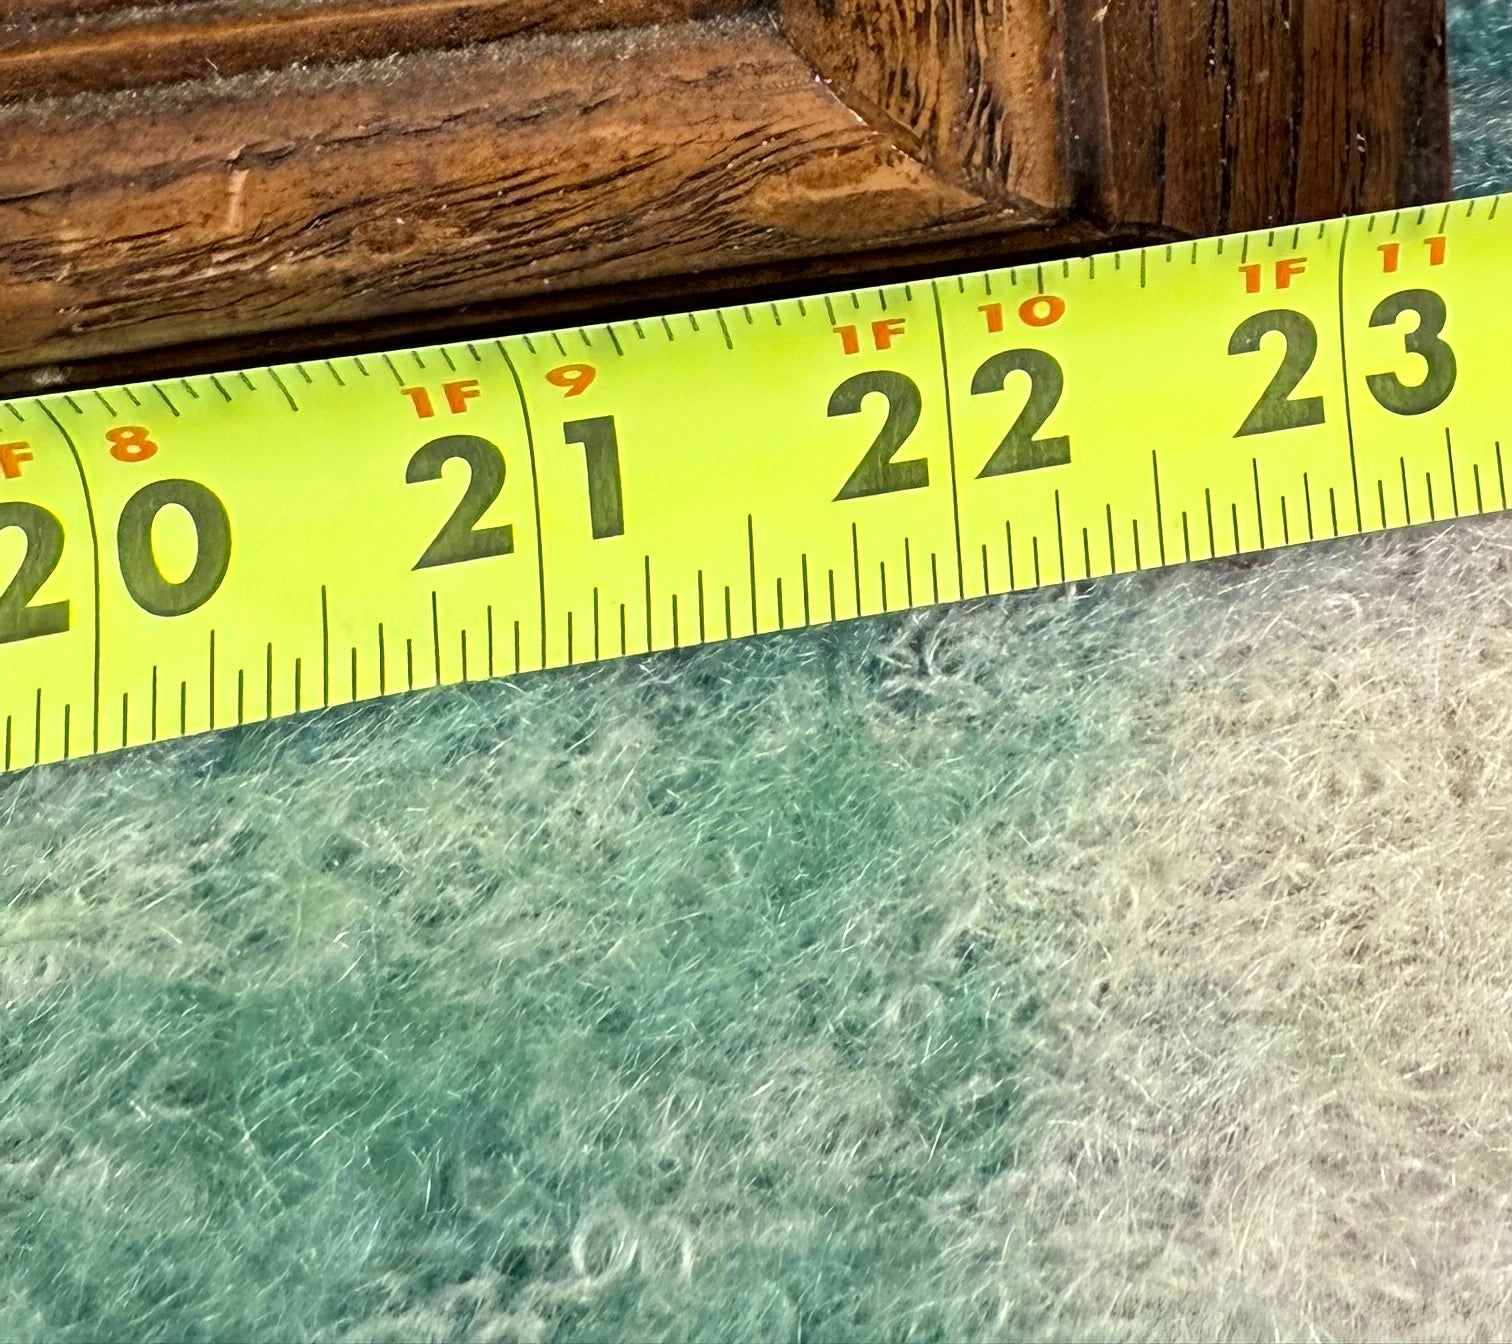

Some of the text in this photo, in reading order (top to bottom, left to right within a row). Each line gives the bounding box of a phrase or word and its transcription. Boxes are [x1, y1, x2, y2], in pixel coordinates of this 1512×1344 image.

[1238, 236, 1447, 294] 1F 11
[833, 295, 1066, 355] 1F 10
[1227, 288, 1458, 439] 23
[400, 363, 598, 419] 1F 9
[825, 347, 1072, 502] 22
[105, 425, 158, 463] 8
[404, 414, 626, 572] 21
[0, 500, 232, 645] 20
